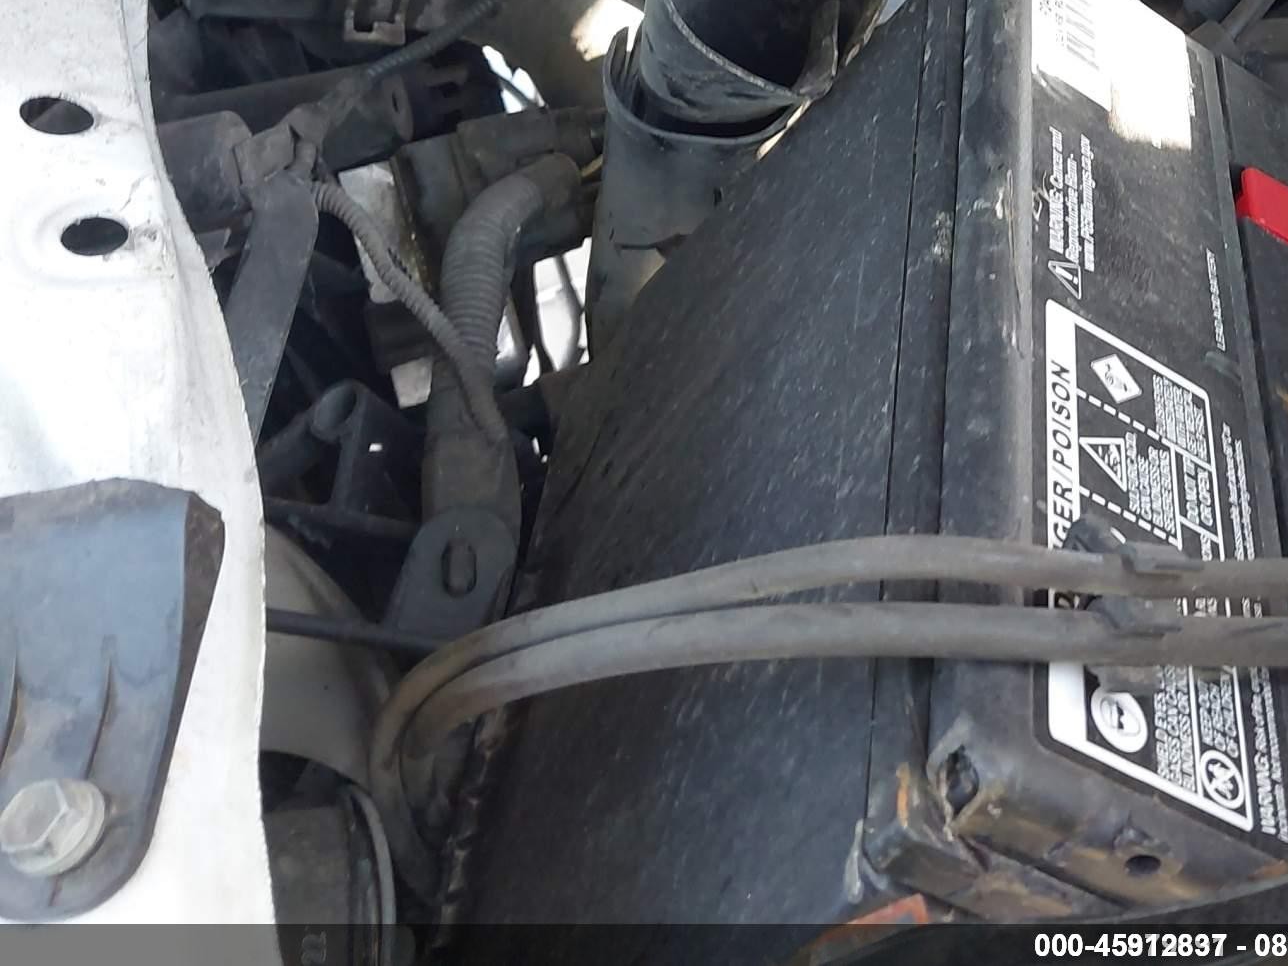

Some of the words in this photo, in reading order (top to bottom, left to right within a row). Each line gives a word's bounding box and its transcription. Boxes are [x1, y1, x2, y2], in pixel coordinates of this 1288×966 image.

[1049, 126, 1062, 152] and
[1050, 152, 1063, 188] Cancer
[1184, 474, 1197, 501] NOT
[1197, 467, 1211, 506] OPEN
[1186, 501, 1199, 524] DO
[1200, 707, 1213, 746] KEEP
[1155, 729, 1169, 780] SHIELD
